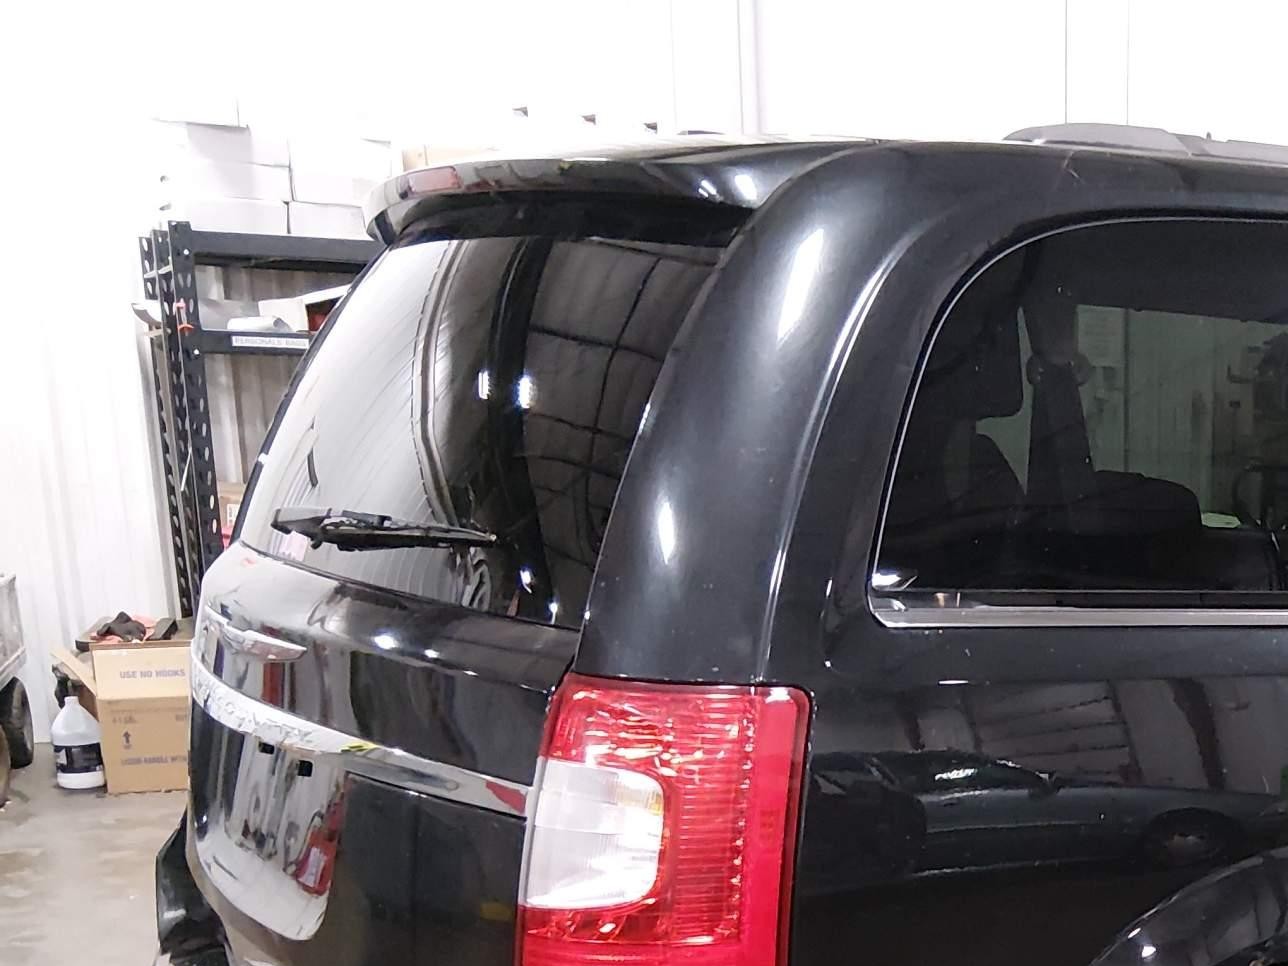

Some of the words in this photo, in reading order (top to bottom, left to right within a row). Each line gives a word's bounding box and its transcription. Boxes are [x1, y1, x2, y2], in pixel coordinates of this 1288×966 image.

[119, 670, 137, 679] USE
[140, 670, 153, 678] NO
[155, 668, 186, 678] HOOKS
